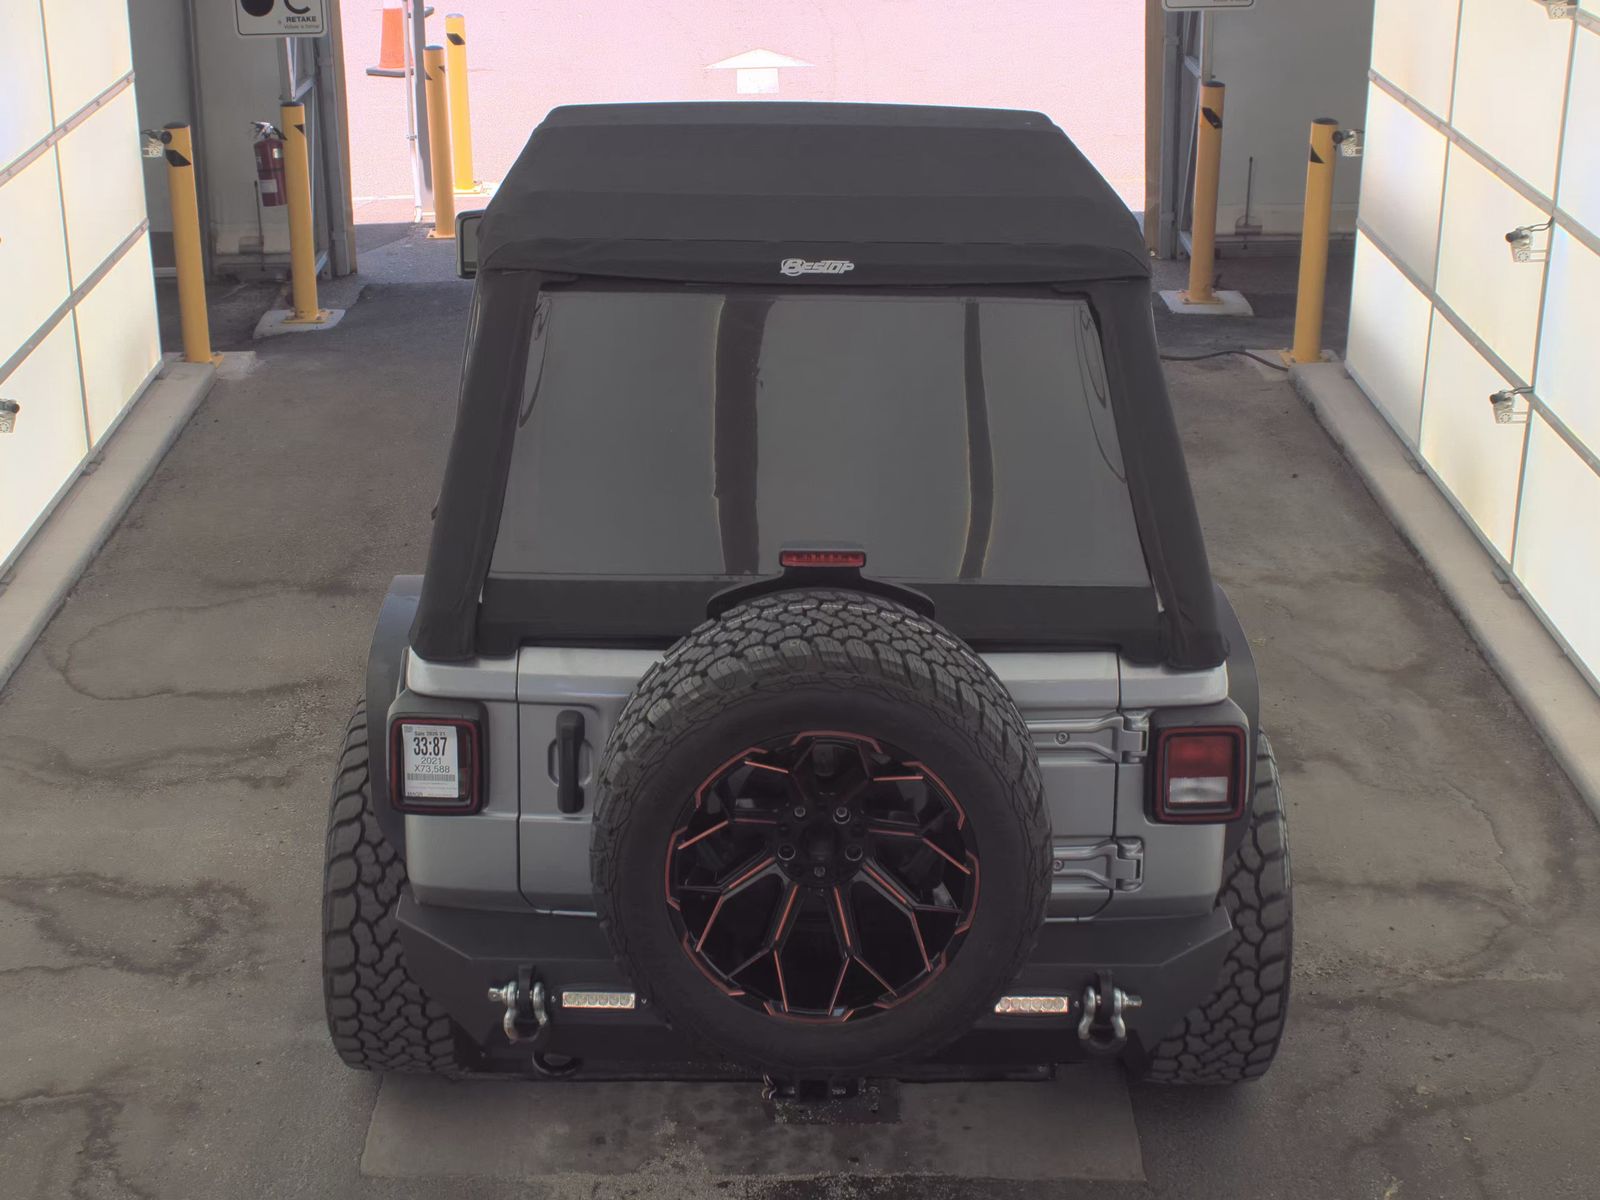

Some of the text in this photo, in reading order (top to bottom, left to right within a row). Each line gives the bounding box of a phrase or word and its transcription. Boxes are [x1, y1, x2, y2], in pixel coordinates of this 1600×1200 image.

[413, 737, 448, 756] 33:87
[421, 757, 442, 765] 2021
[414, 765, 450, 774] X73,588
